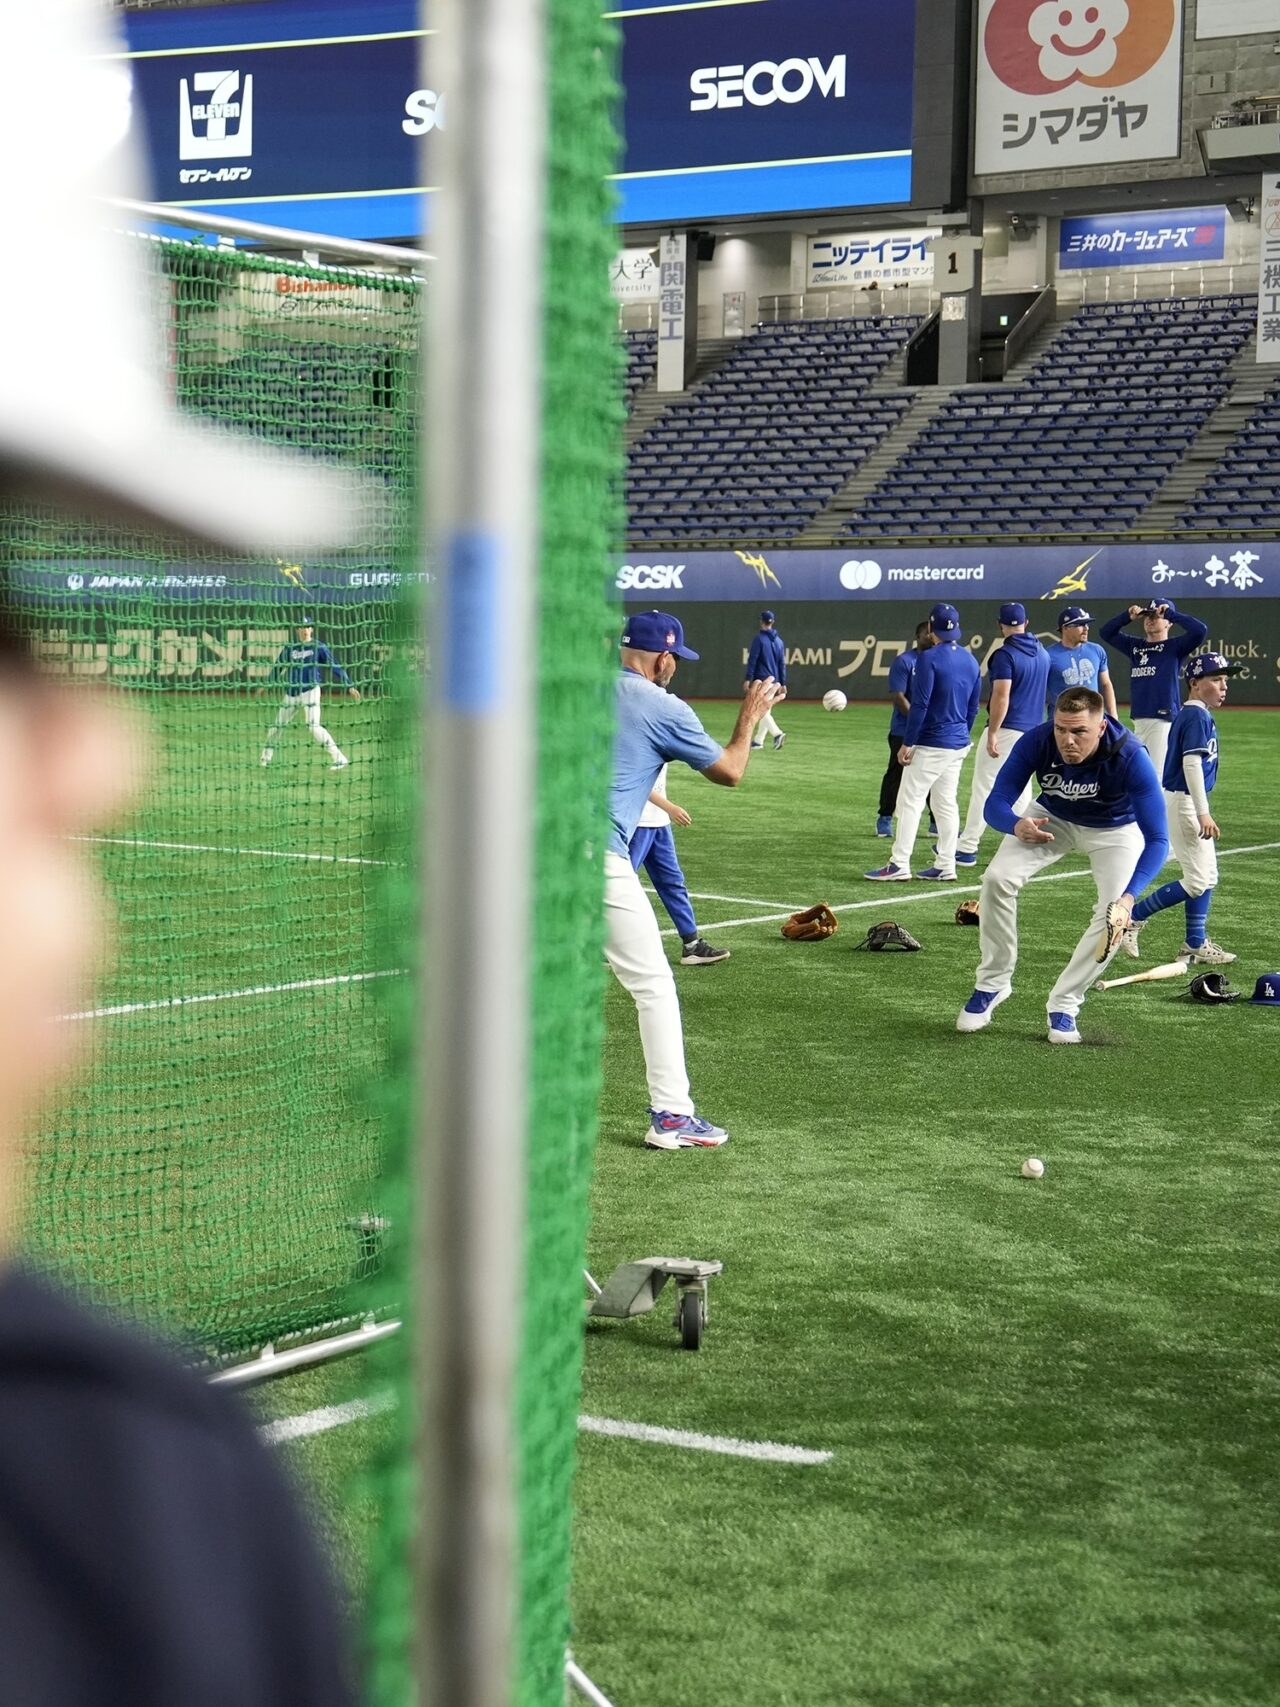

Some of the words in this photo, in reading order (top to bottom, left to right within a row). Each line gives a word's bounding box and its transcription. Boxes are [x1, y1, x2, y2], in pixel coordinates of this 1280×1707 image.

[689, 54, 847, 112] SECOM
[1002, 95, 1149, 150] シマダヤ
[1066, 226, 1197, 253] 三井のカーシェアーズ
[812, 236, 942, 268] ニッテイライ
[948, 252, 959, 274] 1
[853, 266, 935, 280] 信頼の都市型マン
[611, 283, 652, 294] niversity
[659, 261, 685, 341] 関電工
[89, 575, 143, 588] JAPAN
[615, 565, 686, 589] SCSK
[888, 564, 984, 582] mastercard
